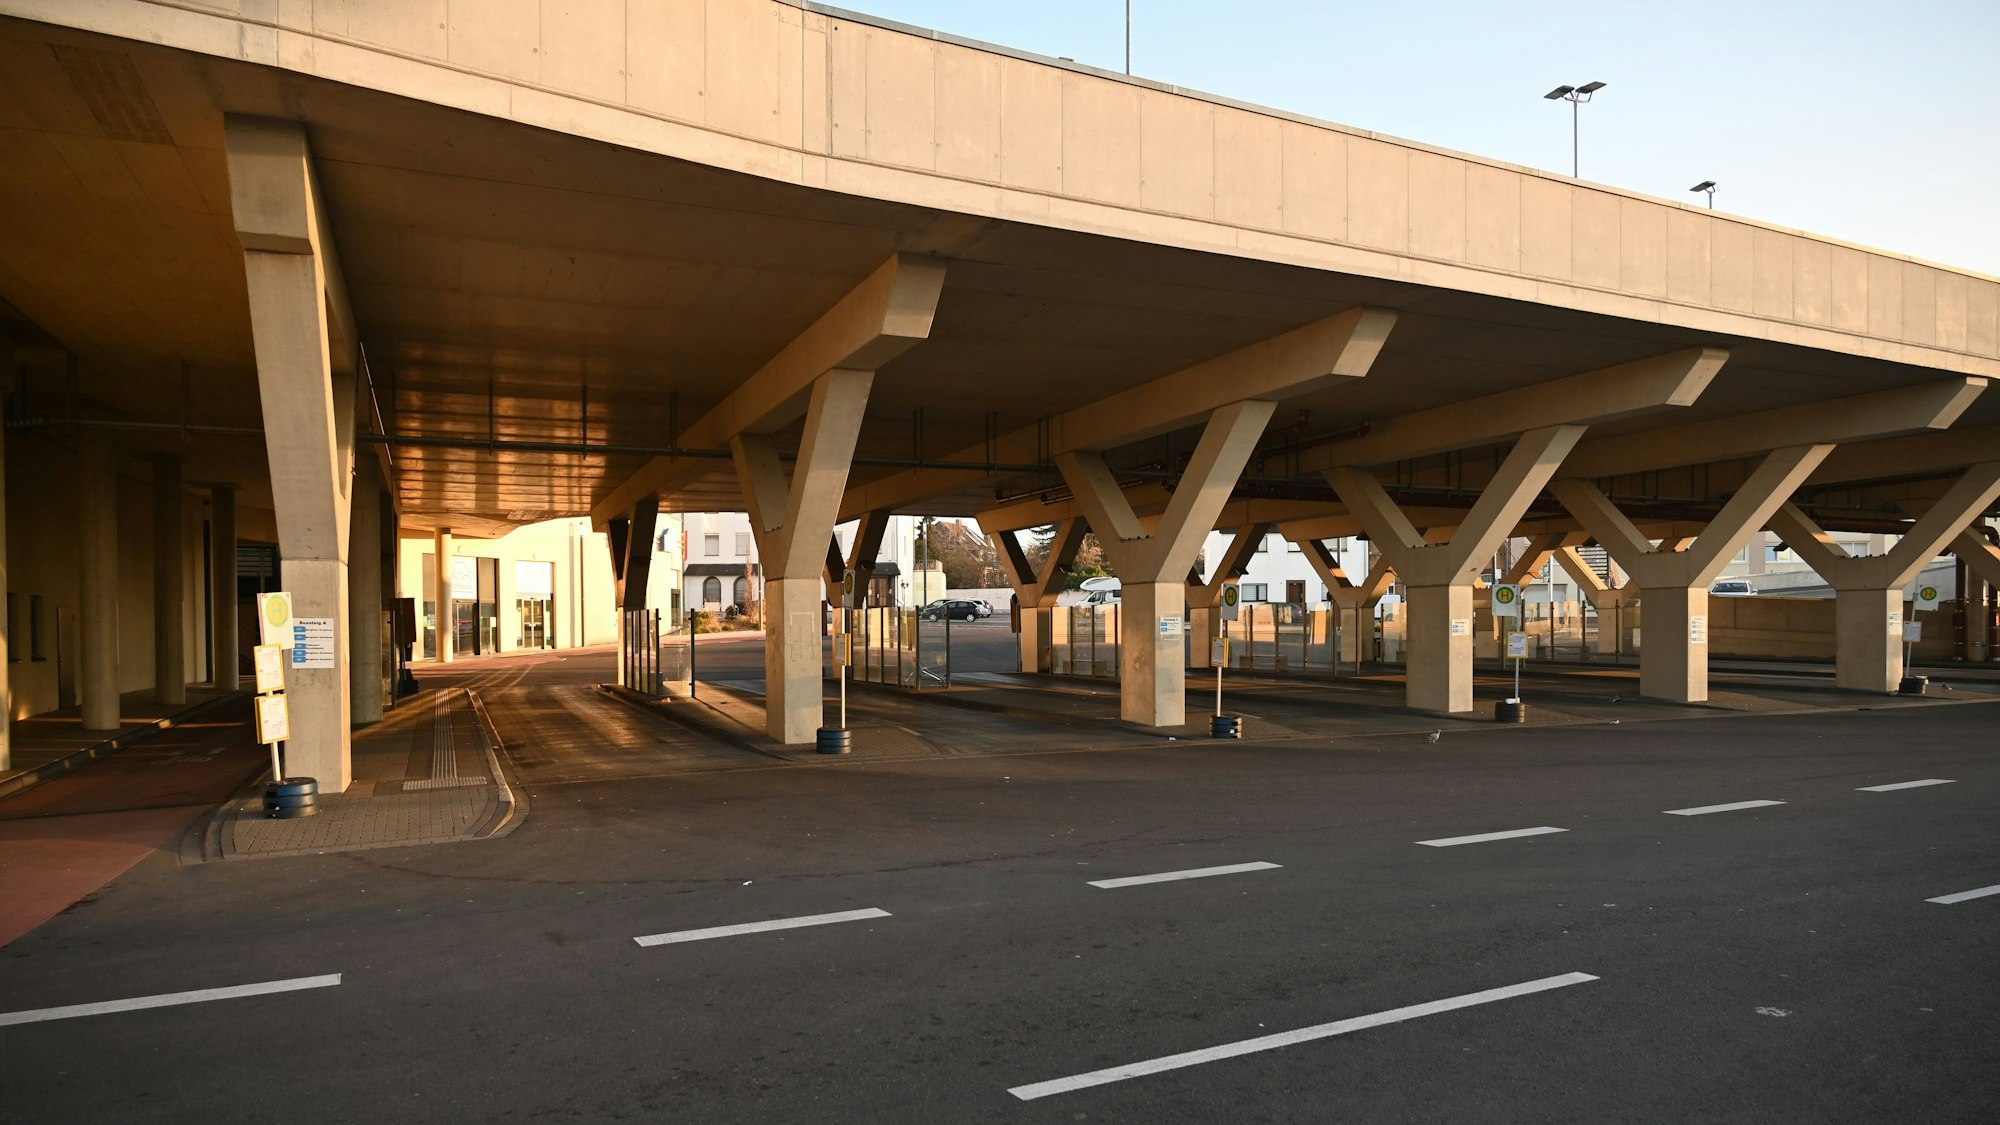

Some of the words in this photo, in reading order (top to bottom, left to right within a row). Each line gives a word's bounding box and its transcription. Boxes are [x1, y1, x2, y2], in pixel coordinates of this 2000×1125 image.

[1228, 591, 1233, 601] H
[1501, 590, 1509, 600] H
[1925, 590, 1932, 598] H
[271, 602, 283, 619] H
